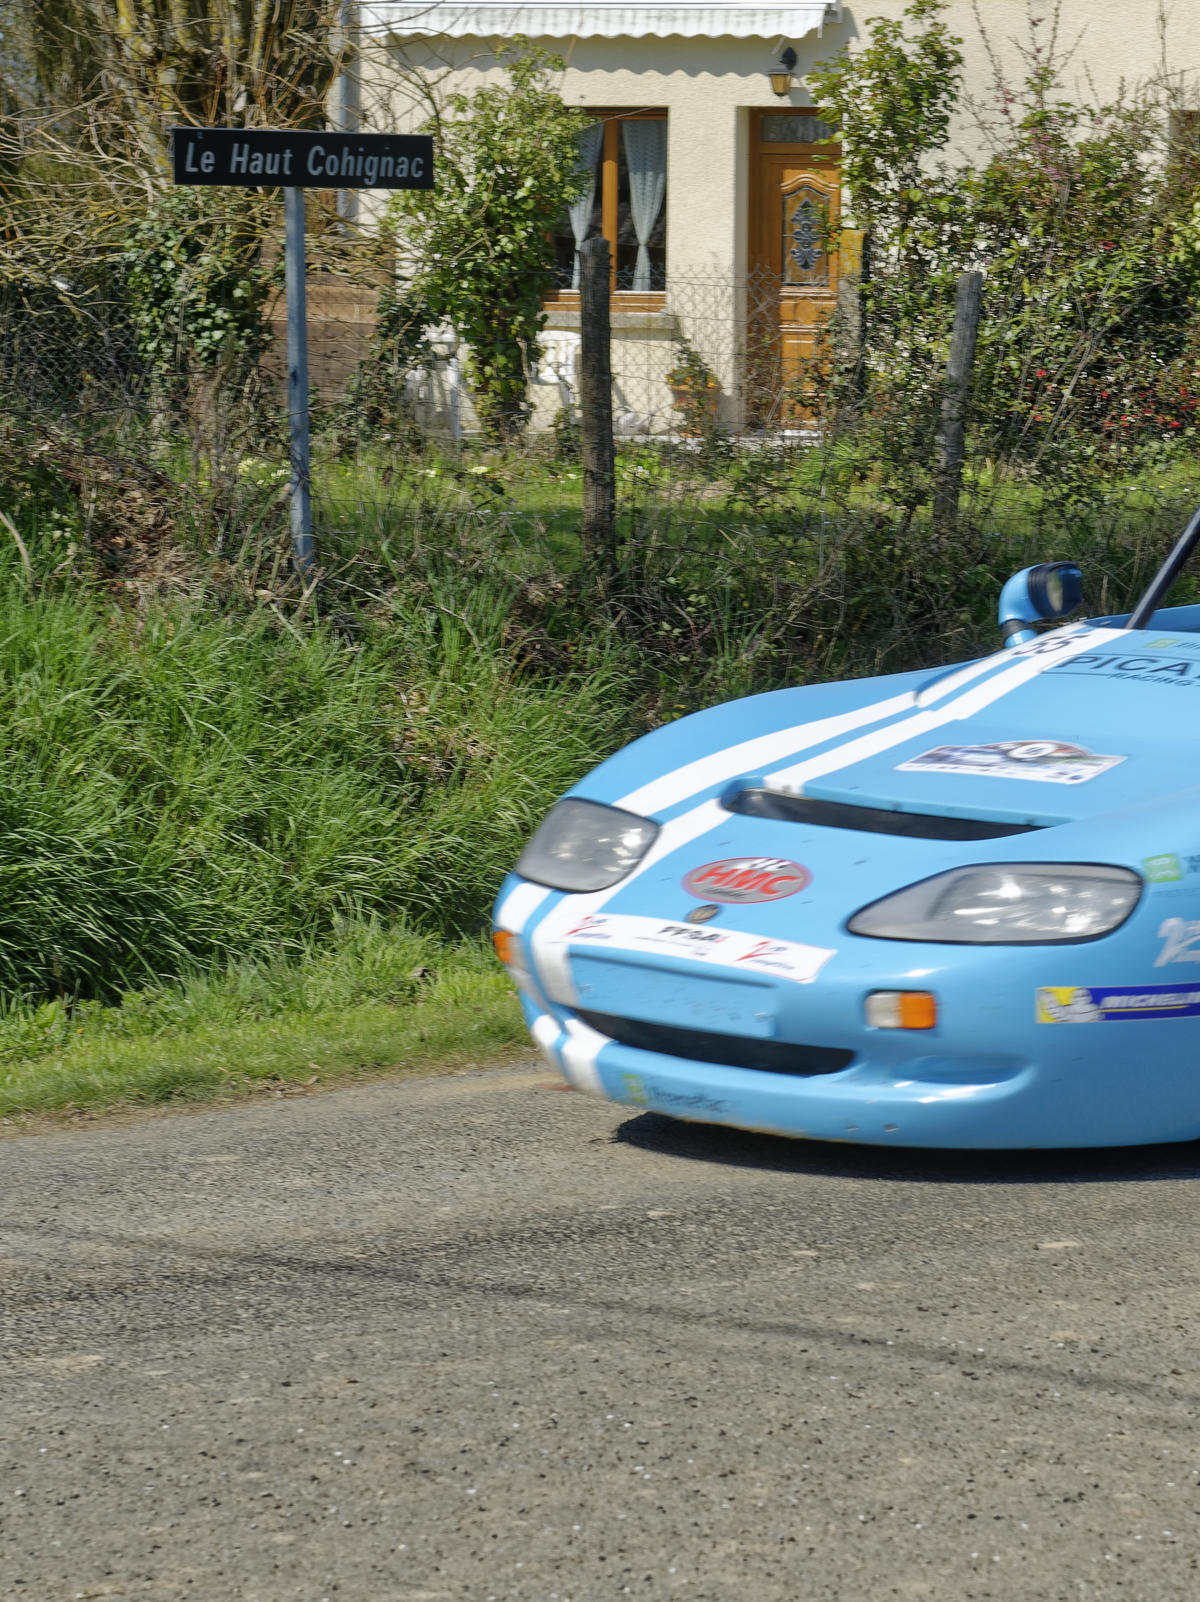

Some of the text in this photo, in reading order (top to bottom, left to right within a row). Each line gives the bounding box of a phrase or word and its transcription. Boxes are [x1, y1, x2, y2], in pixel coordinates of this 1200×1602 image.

[185, 142, 424, 185] Le Haut Cohignac
[696, 865, 799, 895] HMC
